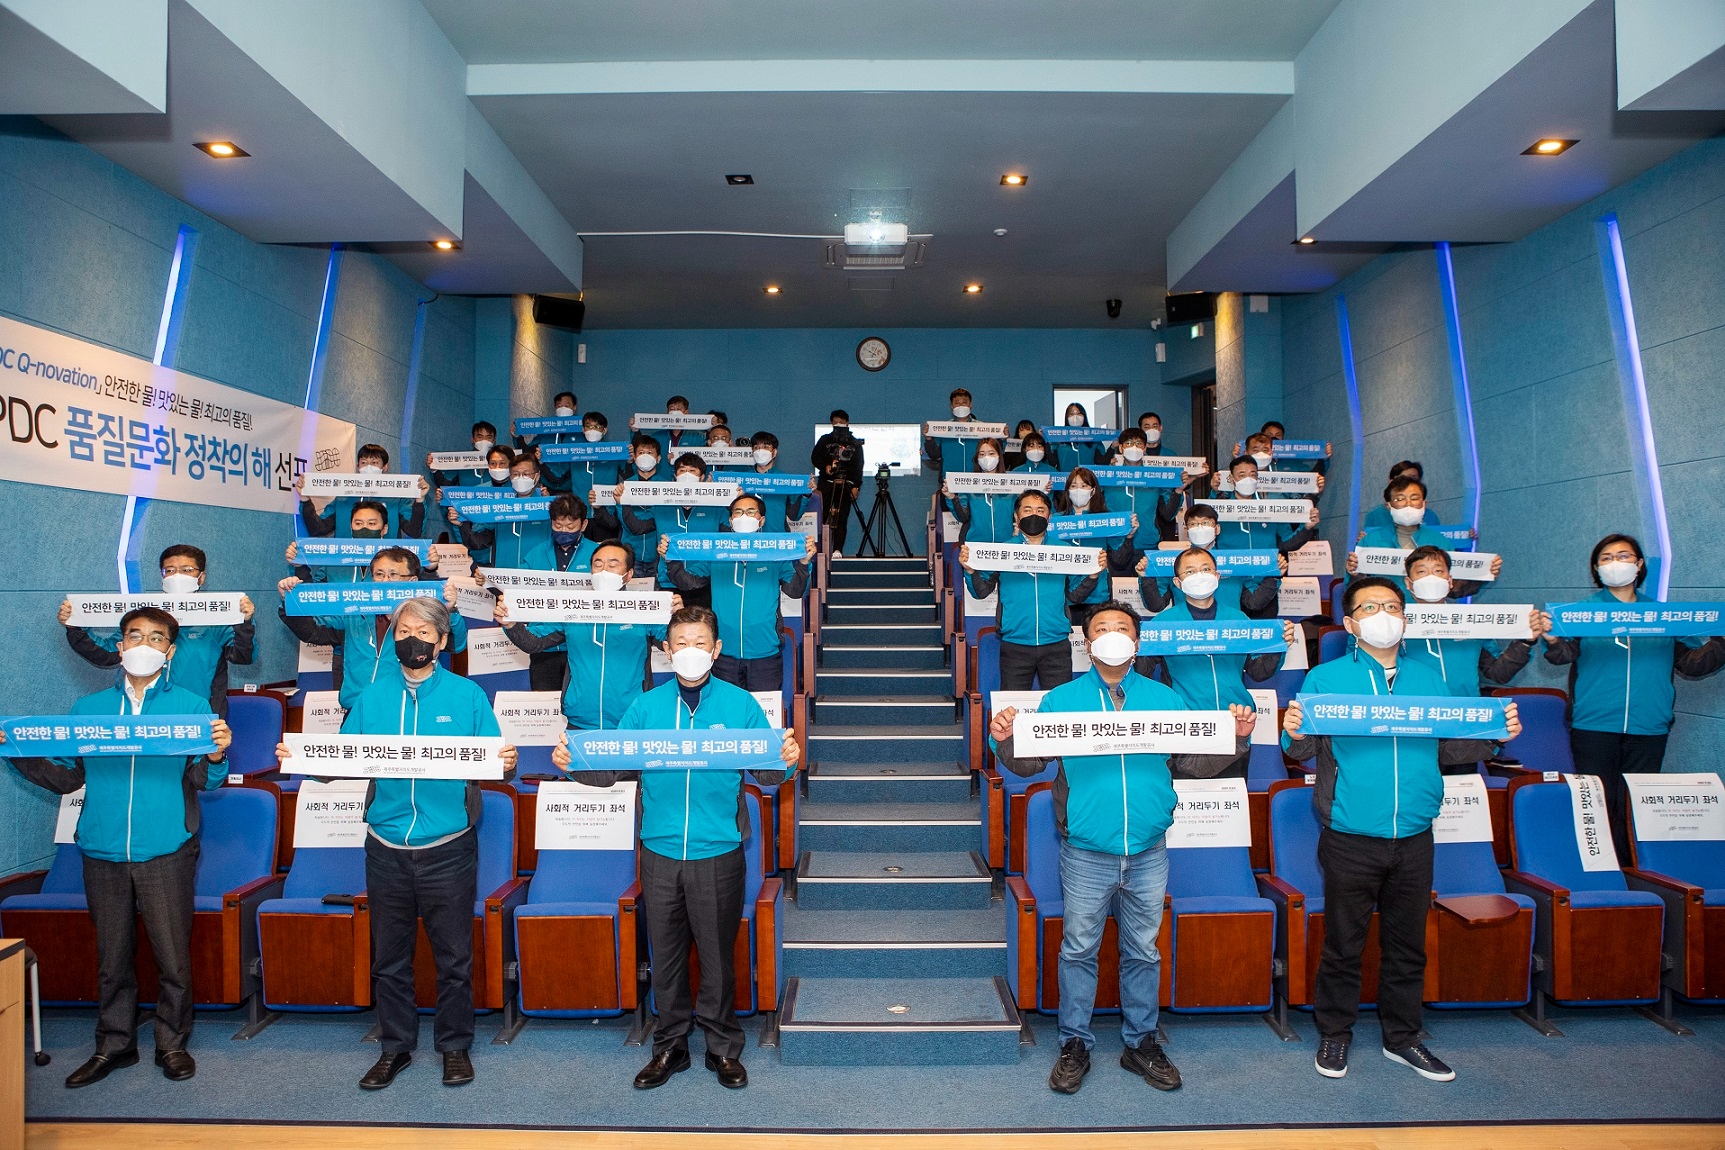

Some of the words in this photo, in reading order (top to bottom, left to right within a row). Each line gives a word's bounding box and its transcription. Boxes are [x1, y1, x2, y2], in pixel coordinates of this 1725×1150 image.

[105, 375, 141, 404] 안전한
[142, 385, 155, 407] 물!
[159, 390, 189, 416] 맛있는
[191, 400, 204, 419] 물!
[204, 403, 231, 426] 최고의
[233, 410, 253, 430] 품질!
[64, 406, 180, 475] 품질문화
[184, 433, 248, 486] 정착의
[252, 447, 271, 489] 해
[312, 479, 332, 488] 안전한
[333, 479, 342, 488] 물!
[344, 479, 364, 488] 맛있는
[364, 479, 373, 488] 물!
[376, 480, 395, 488] 최고의
[396, 480, 411, 489] 품질!
[630, 487, 651, 496] 안전한
[651, 487, 660, 496] 물!
[662, 488, 683, 496] 맛있는
[683, 488, 692, 496] 물!
[695, 488, 714, 497] 최고의
[715, 488, 731, 497] 품질!
[1236, 504, 1256, 513] 맛있는
[1268, 505, 1288, 513] 최고의
[1289, 505, 1304, 513] 품질!
[304, 544, 328, 554] 안전한
[328, 544, 338, 554] 물!
[341, 545, 364, 554] 맛있는
[365, 545, 375, 554] 물!
[677, 540, 702, 549] 안전한
[702, 540, 713, 549] 물!
[716, 540, 739, 549] 맛있는
[740, 540, 750, 549] 물!
[754, 540, 777, 549] 최고의
[778, 540, 796, 549] 품질!
[976, 550, 1000, 560] 안전한
[1000, 551, 1010, 560] 물!
[1013, 552, 1036, 561] 맛있는
[1037, 552, 1047, 562] 물!
[1050, 553, 1072, 562] 최고의
[1073, 554, 1091, 563] 품질!
[1229, 556, 1252, 565] 최고의
[1253, 556, 1270, 565] 품질!
[1366, 555, 1390, 565] 안전한
[1391, 556, 1401, 566] 물!
[1465, 559, 1483, 569] 품질!
[488, 575, 511, 584] 안전한
[512, 575, 522, 585] 물!
[524, 576, 547, 586] 맛있는
[548, 577, 558, 586] 물!
[560, 577, 583, 587] 최고의
[298, 591, 326, 602] 안전한
[327, 591, 339, 602] 물!
[343, 590, 370, 601] 맛있는
[371, 590, 383, 601] 물!
[387, 589, 414, 600] 최고의
[81, 602, 112, 614] 안전한
[113, 602, 126, 613] 물!
[177, 601, 206, 613] 최고의
[208, 600, 231, 612] 품질!
[516, 598, 546, 609] 안전한
[546, 598, 559, 609] 물!
[562, 598, 591, 610] 맛있는
[592, 599, 604, 610] 물!
[608, 599, 636, 610] 최고의
[638, 599, 660, 610] 품질!
[1406, 613, 1417, 624] 물!
[1420, 613, 1449, 624] 맛있는
[1450, 613, 1462, 624] 물!
[1466, 613, 1494, 624] 최고의
[1496, 613, 1517, 624] 품질!
[1561, 611, 1593, 622] 안전한
[1594, 611, 1608, 622] 물!
[1612, 611, 1643, 622] 맛있는
[1644, 611, 1658, 622] 물!
[1662, 611, 1693, 622] 최고의
[1694, 610, 1718, 622] 품질!
[1140, 630, 1158, 642] 전한
[1159, 630, 1172, 641] 물!
[1175, 630, 1204, 641] 맛있는
[1205, 629, 1217, 640] 물!
[1221, 629, 1250, 640] 최고의
[1251, 628, 1273, 640] 품질!
[1314, 704, 1350, 719] 안전한
[1351, 705, 1367, 720] 물!
[1371, 706, 1407, 720] 맛있는
[1408, 706, 1424, 721] 물!
[1428, 707, 1463, 722] 최고의
[1465, 707, 1493, 722] 품질!
[13, 726, 51, 740] 안전한
[53, 726, 69, 740] 물!
[74, 726, 111, 740] 맛있는
[113, 725, 128, 739] 물!
[134, 725, 170, 739] 최고의
[173, 725, 201, 739] 품질!
[1032, 723, 1070, 739] 안전한
[1071, 723, 1087, 738] 물!
[1092, 723, 1128, 738] 맛있는
[1130, 722, 1145, 737] 물!
[1150, 722, 1186, 737] 최고의
[1188, 721, 1216, 737] 품질!
[303, 744, 340, 759] 안전한
[342, 745, 357, 759] 물!
[362, 745, 398, 760] 맛있는
[400, 746, 416, 760] 물!
[421, 746, 456, 761] 최고의
[458, 747, 486, 761] 품질!
[583, 740, 621, 755] 안전한
[622, 740, 638, 755] 물!
[643, 740, 679, 755] 맛있는
[681, 740, 696, 755] 물!
[702, 740, 738, 755] 최고의
[740, 739, 768, 754] 품질!
[1464, 796, 1479, 805] 좌석
[1580, 782, 1592, 809] 맛있는
[1641, 796, 1664, 804] 사회적
[1668, 796, 1698, 804] 거리두기
[305, 802, 329, 811] 사회적
[546, 804, 569, 813] 사회적
[574, 804, 605, 813] 거리두기
[610, 804, 626, 813] 좌석
[1188, 802, 1220, 810] 거리두기
[1224, 801, 1240, 810] 좌석
[1583, 813, 1595, 825] 물!
[1585, 827, 1600, 856] 안전한
